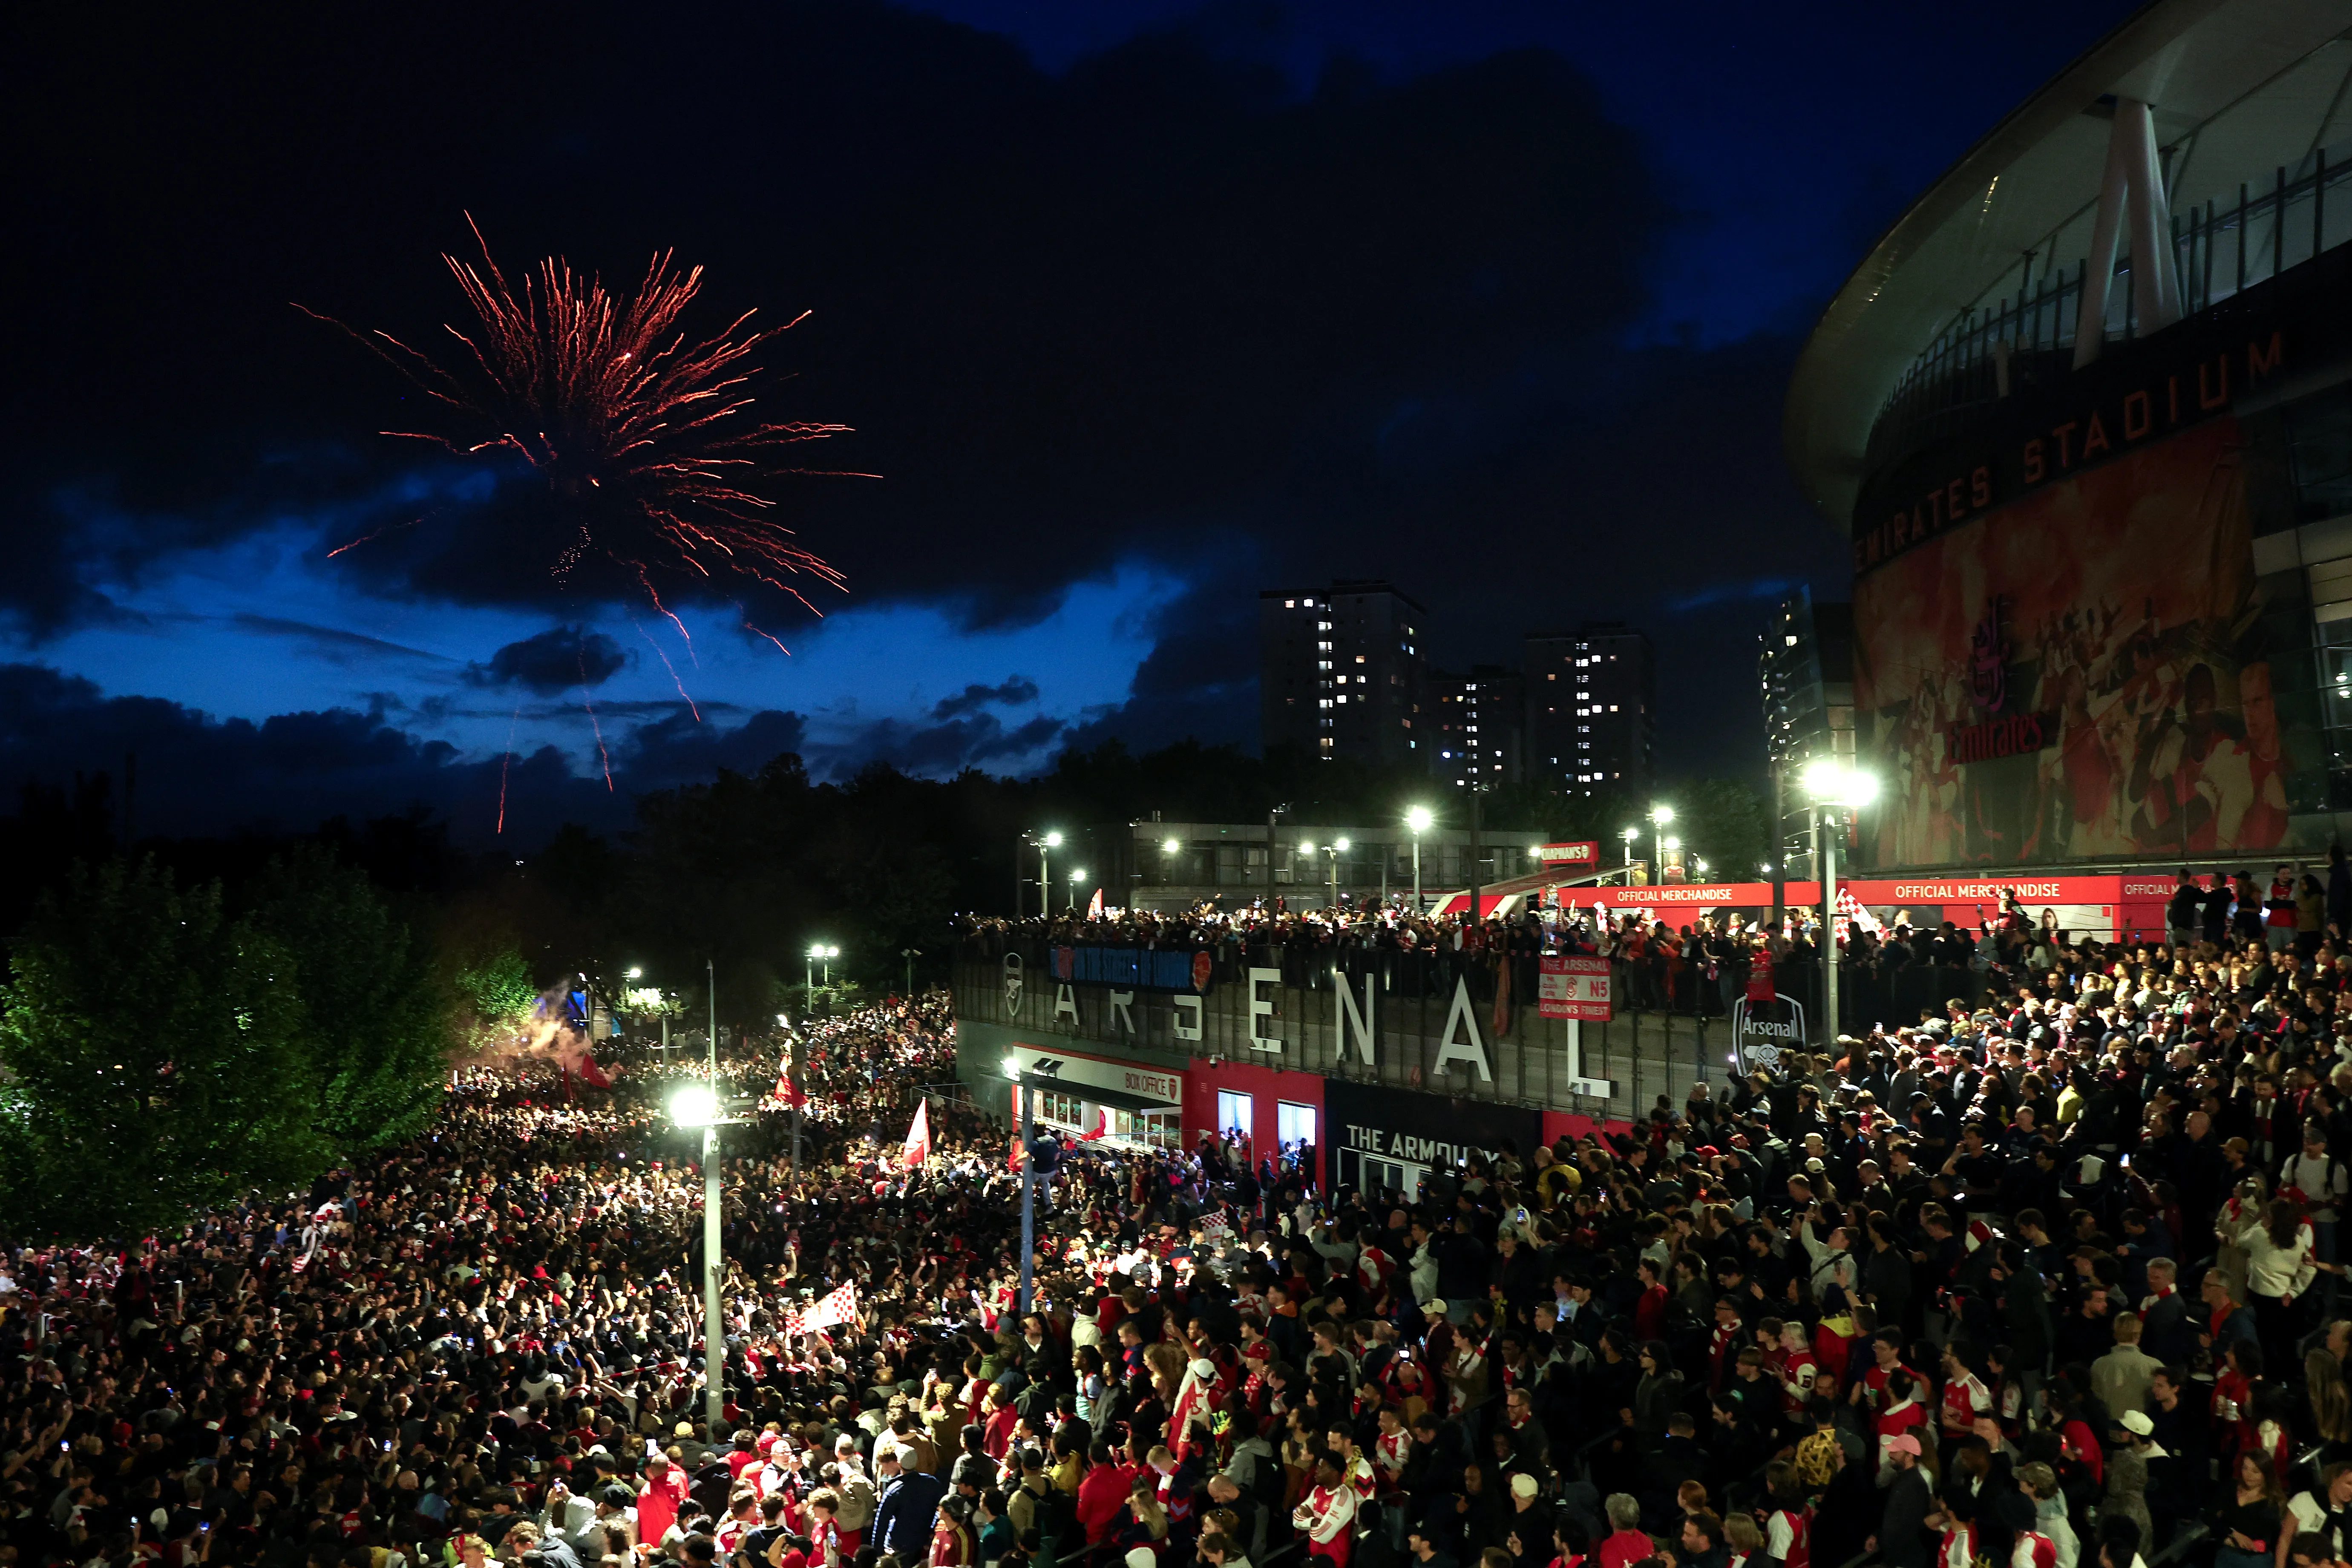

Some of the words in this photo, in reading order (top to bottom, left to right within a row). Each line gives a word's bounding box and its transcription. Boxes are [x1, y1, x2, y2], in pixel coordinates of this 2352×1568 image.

[1855, 466, 1991, 574] EMIRATES
[2022, 331, 2285, 484] STADIUM
[1946, 711, 2043, 765] Emirates
[1617, 891, 1659, 902] OFFICIAL
[1661, 888, 1733, 901] MERCHANDISE
[1895, 885, 1955, 898] OFFICIAL
[2124, 884, 2170, 895] OFFICIAL
[1542, 958, 1561, 971] THE
[1563, 959, 1608, 972] ARSENAL
[1589, 981, 1608, 998] N5
[1581, 1005, 1609, 1016] FINEST
[1742, 1016, 1795, 1038] Arsenal
[1125, 1072, 1140, 1091] BOX
[1143, 1076, 1166, 1096] OFFICE
[1346, 1124, 1384, 1152] THE
[1390, 1132, 1500, 1167] ARMOUY
